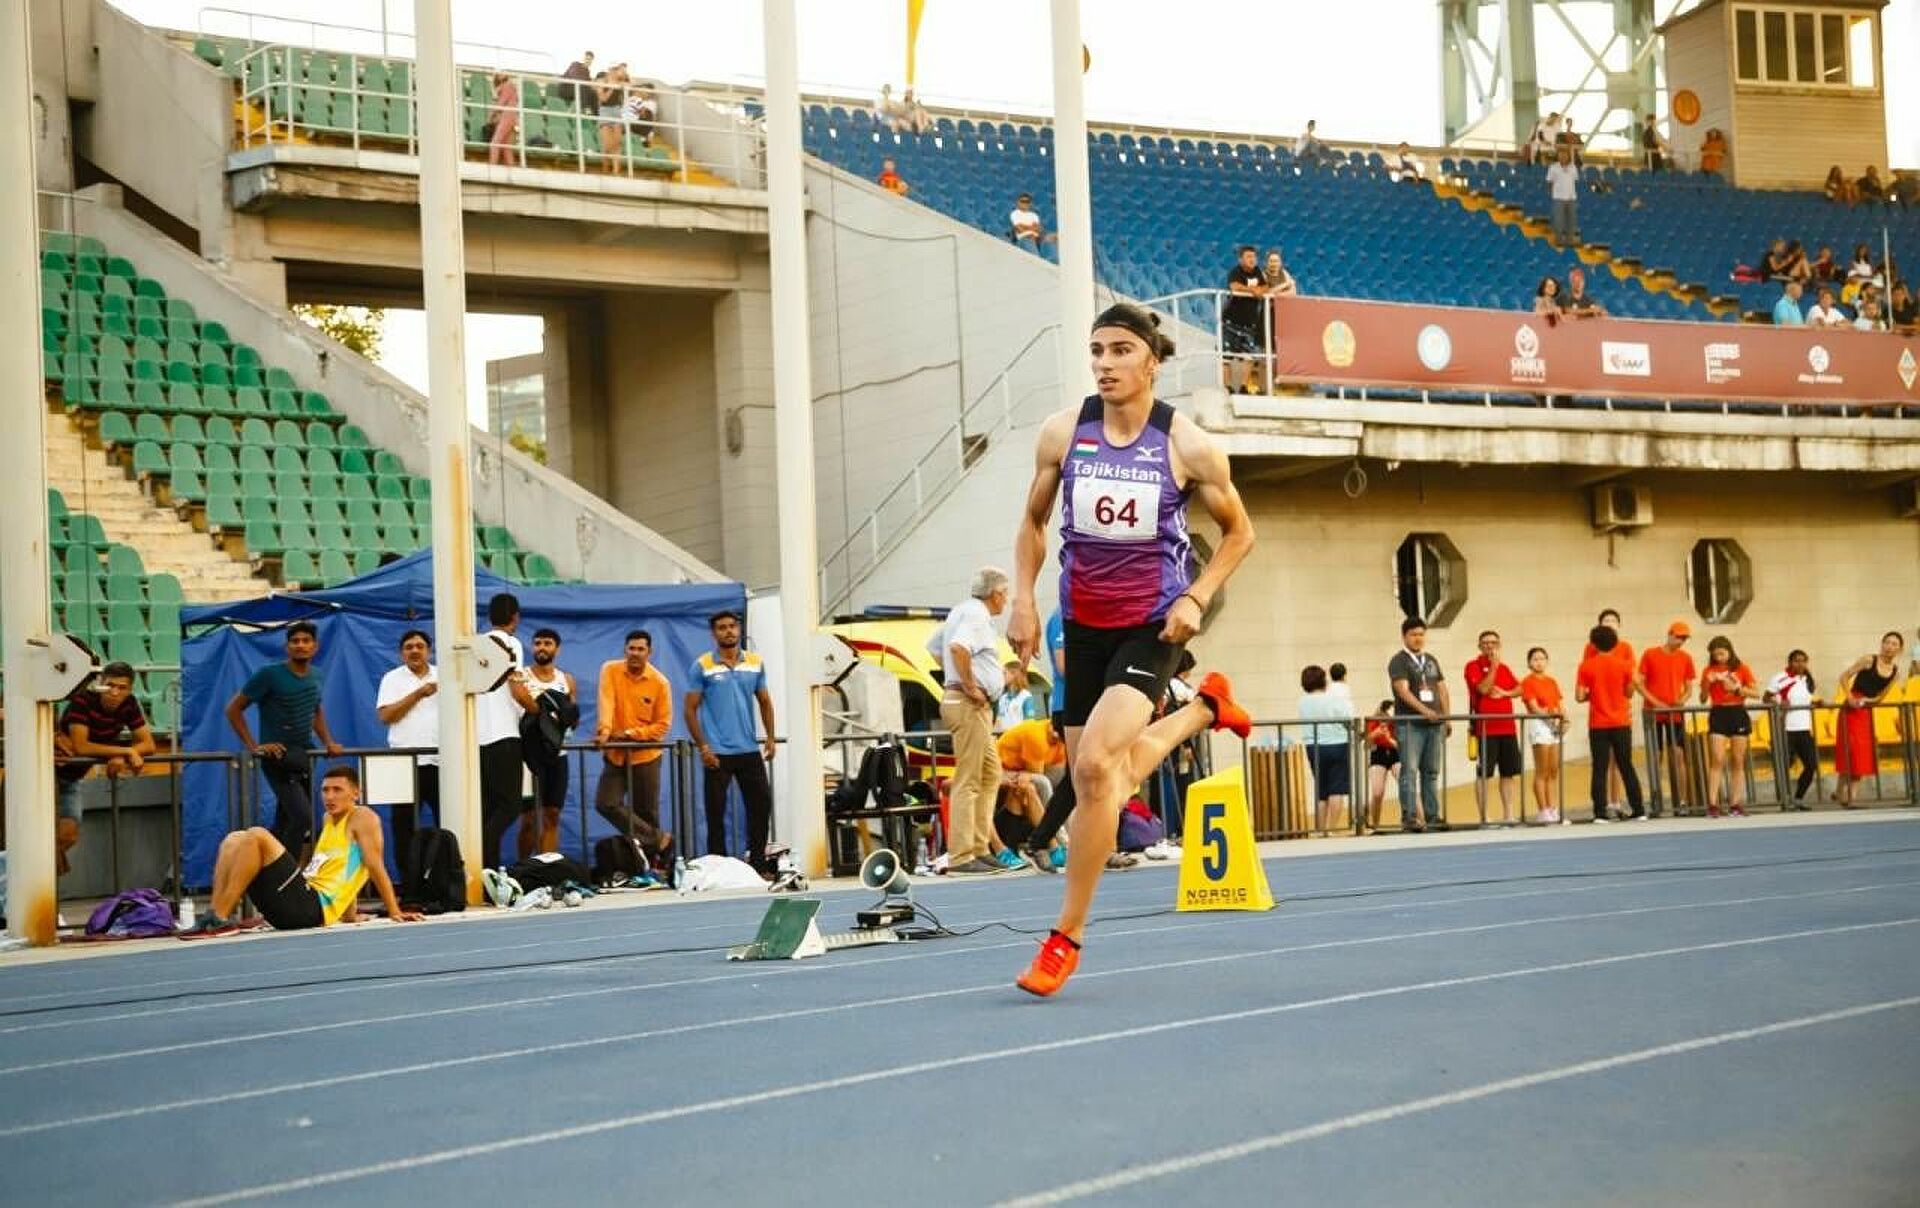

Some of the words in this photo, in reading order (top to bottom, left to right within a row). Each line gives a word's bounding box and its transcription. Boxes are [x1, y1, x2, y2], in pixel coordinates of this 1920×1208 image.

[1072, 460, 1161, 481] Tajikistan
[1095, 496, 1138, 528] 64
[1202, 804, 1228, 880] 5
[1187, 888, 1247, 899] NORDIC
